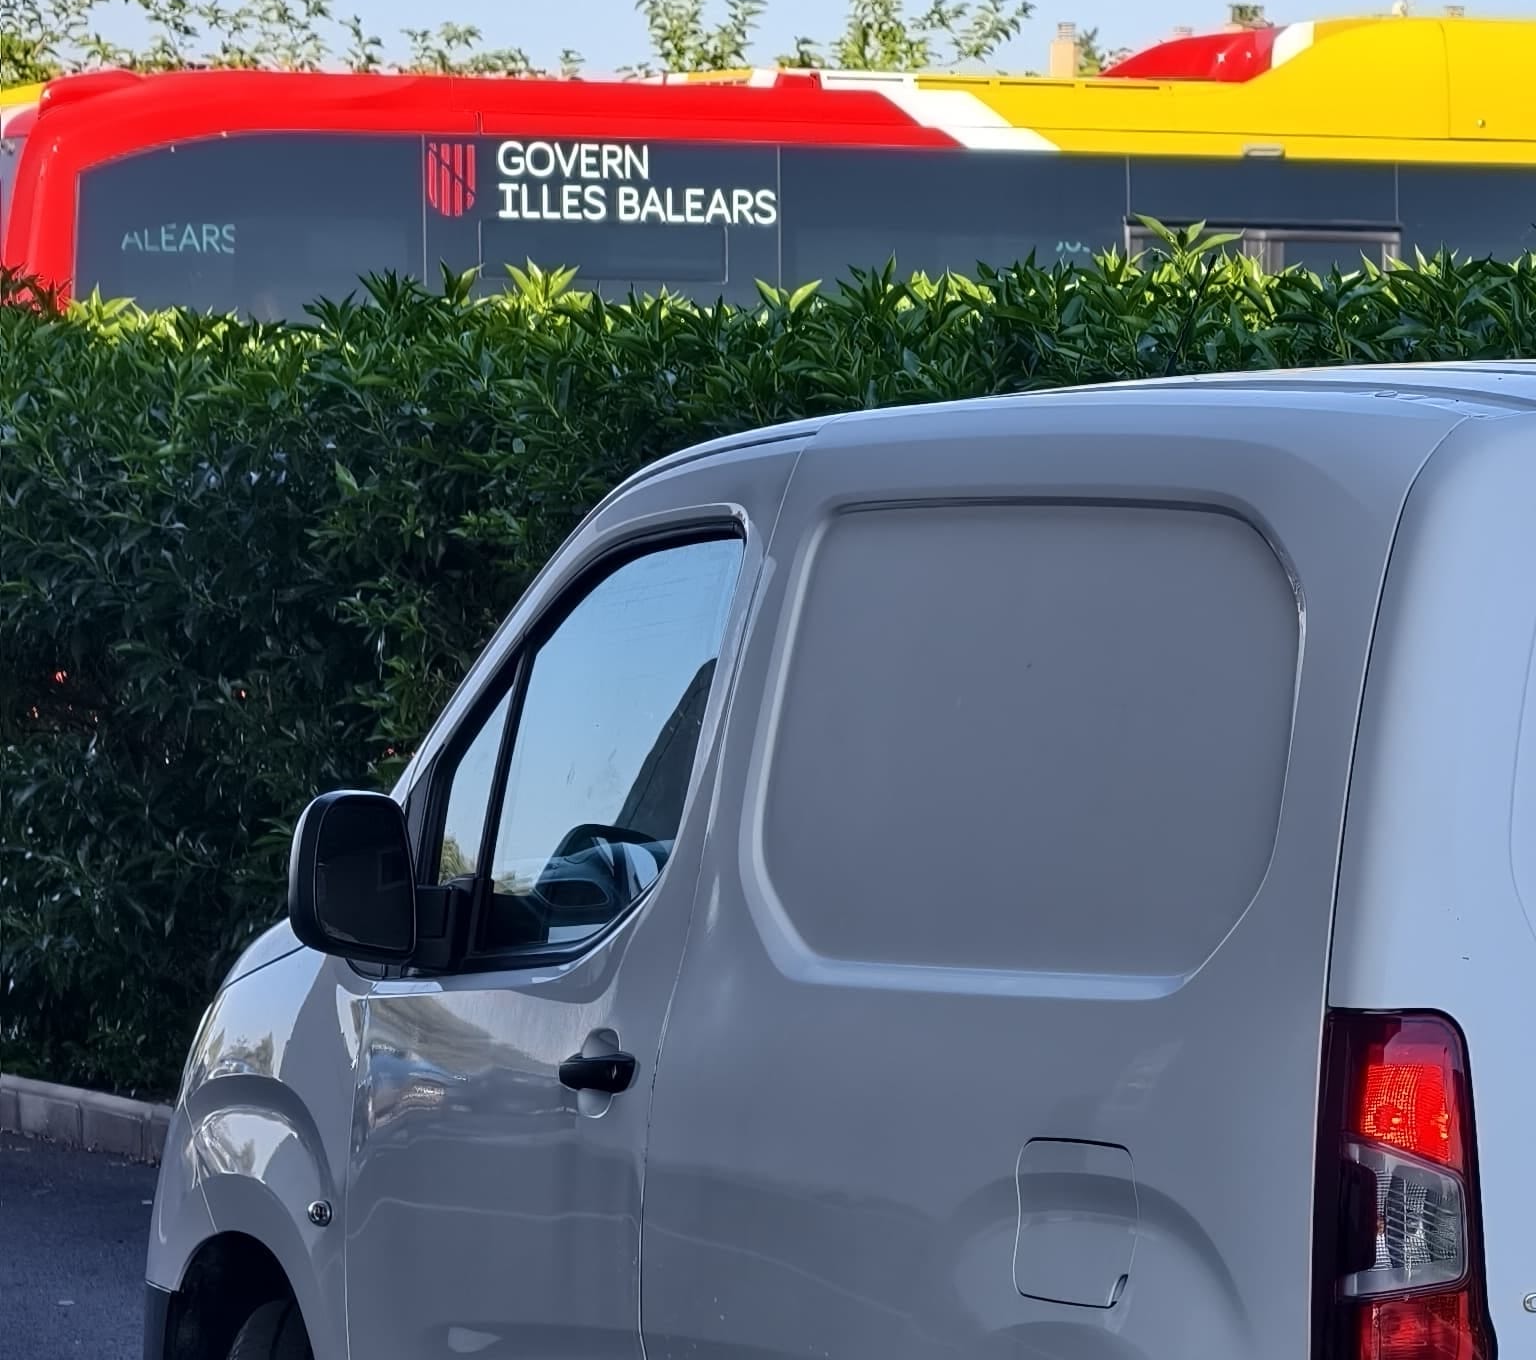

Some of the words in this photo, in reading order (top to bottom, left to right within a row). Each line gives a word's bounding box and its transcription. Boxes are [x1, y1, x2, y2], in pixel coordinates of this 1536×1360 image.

[498, 141, 649, 179] GOVERN
[498, 183, 606, 220] ILLES
[618, 186, 777, 225] BALEARS
[121, 223, 235, 254] ALEARS
